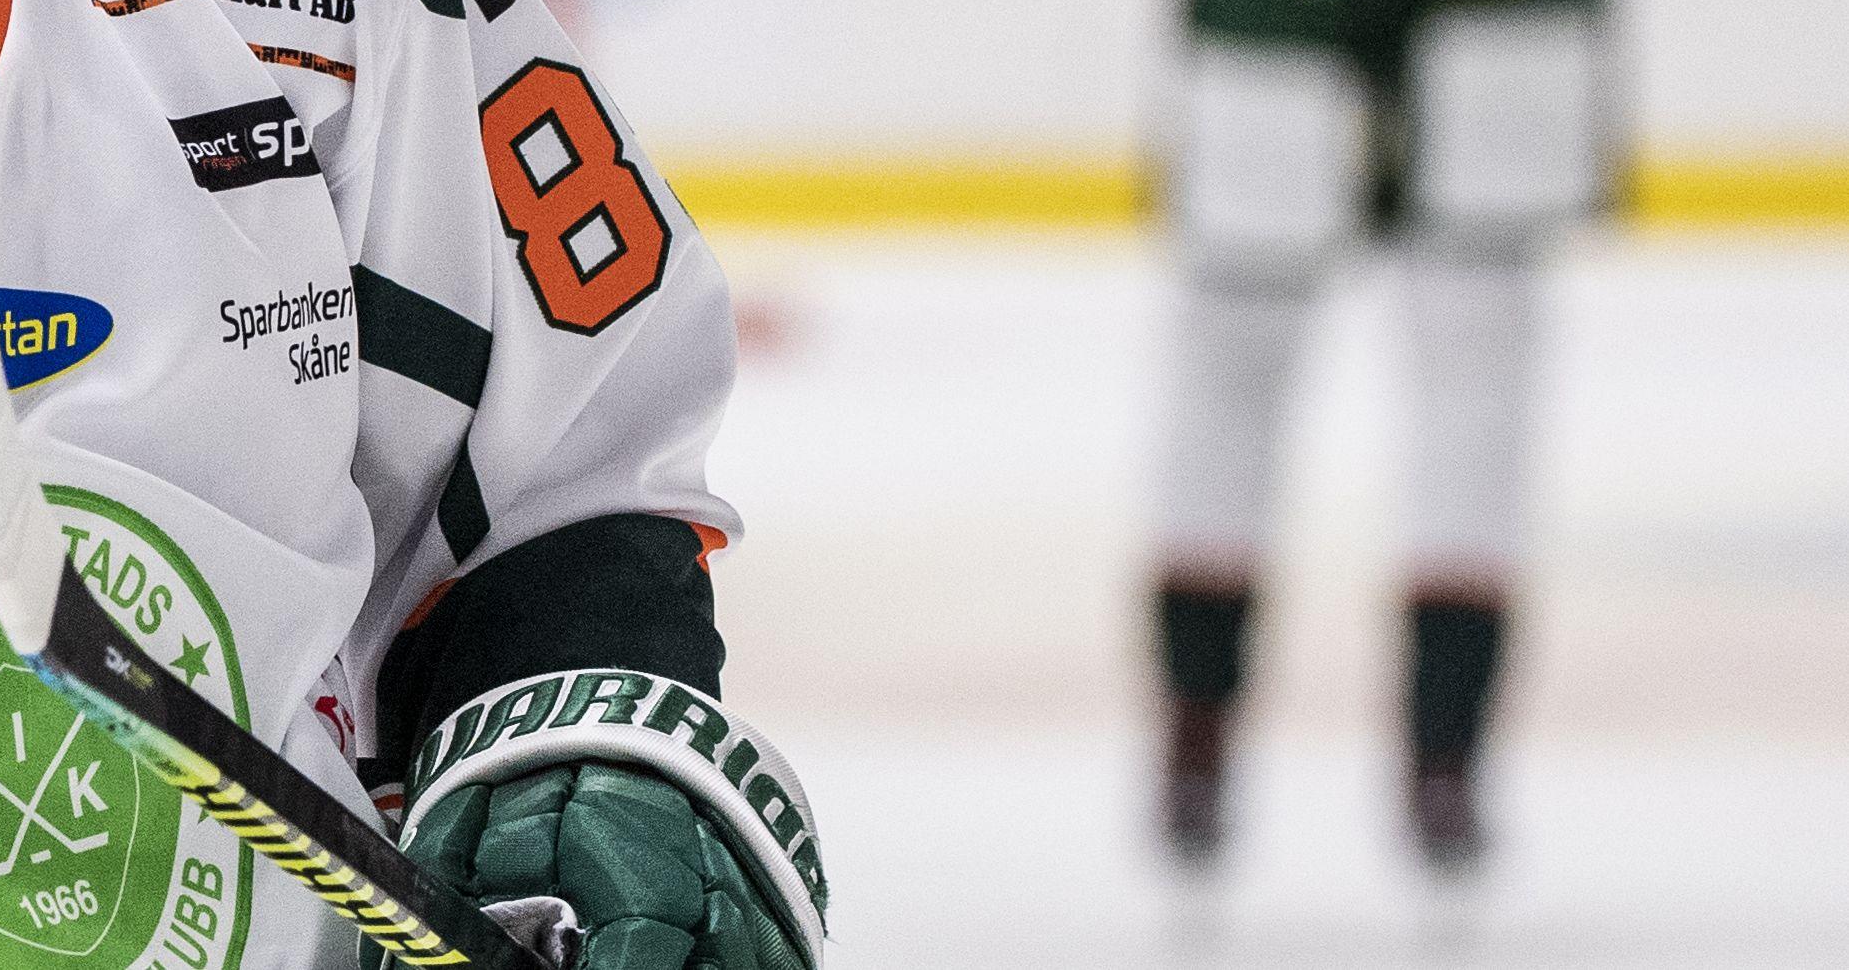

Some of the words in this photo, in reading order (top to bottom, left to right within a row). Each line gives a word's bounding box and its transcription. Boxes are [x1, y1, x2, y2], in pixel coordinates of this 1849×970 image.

[219, 280, 353, 351] Sparbanken
[288, 332, 351, 386] Skåne
[19, 879, 99, 930] 1966
